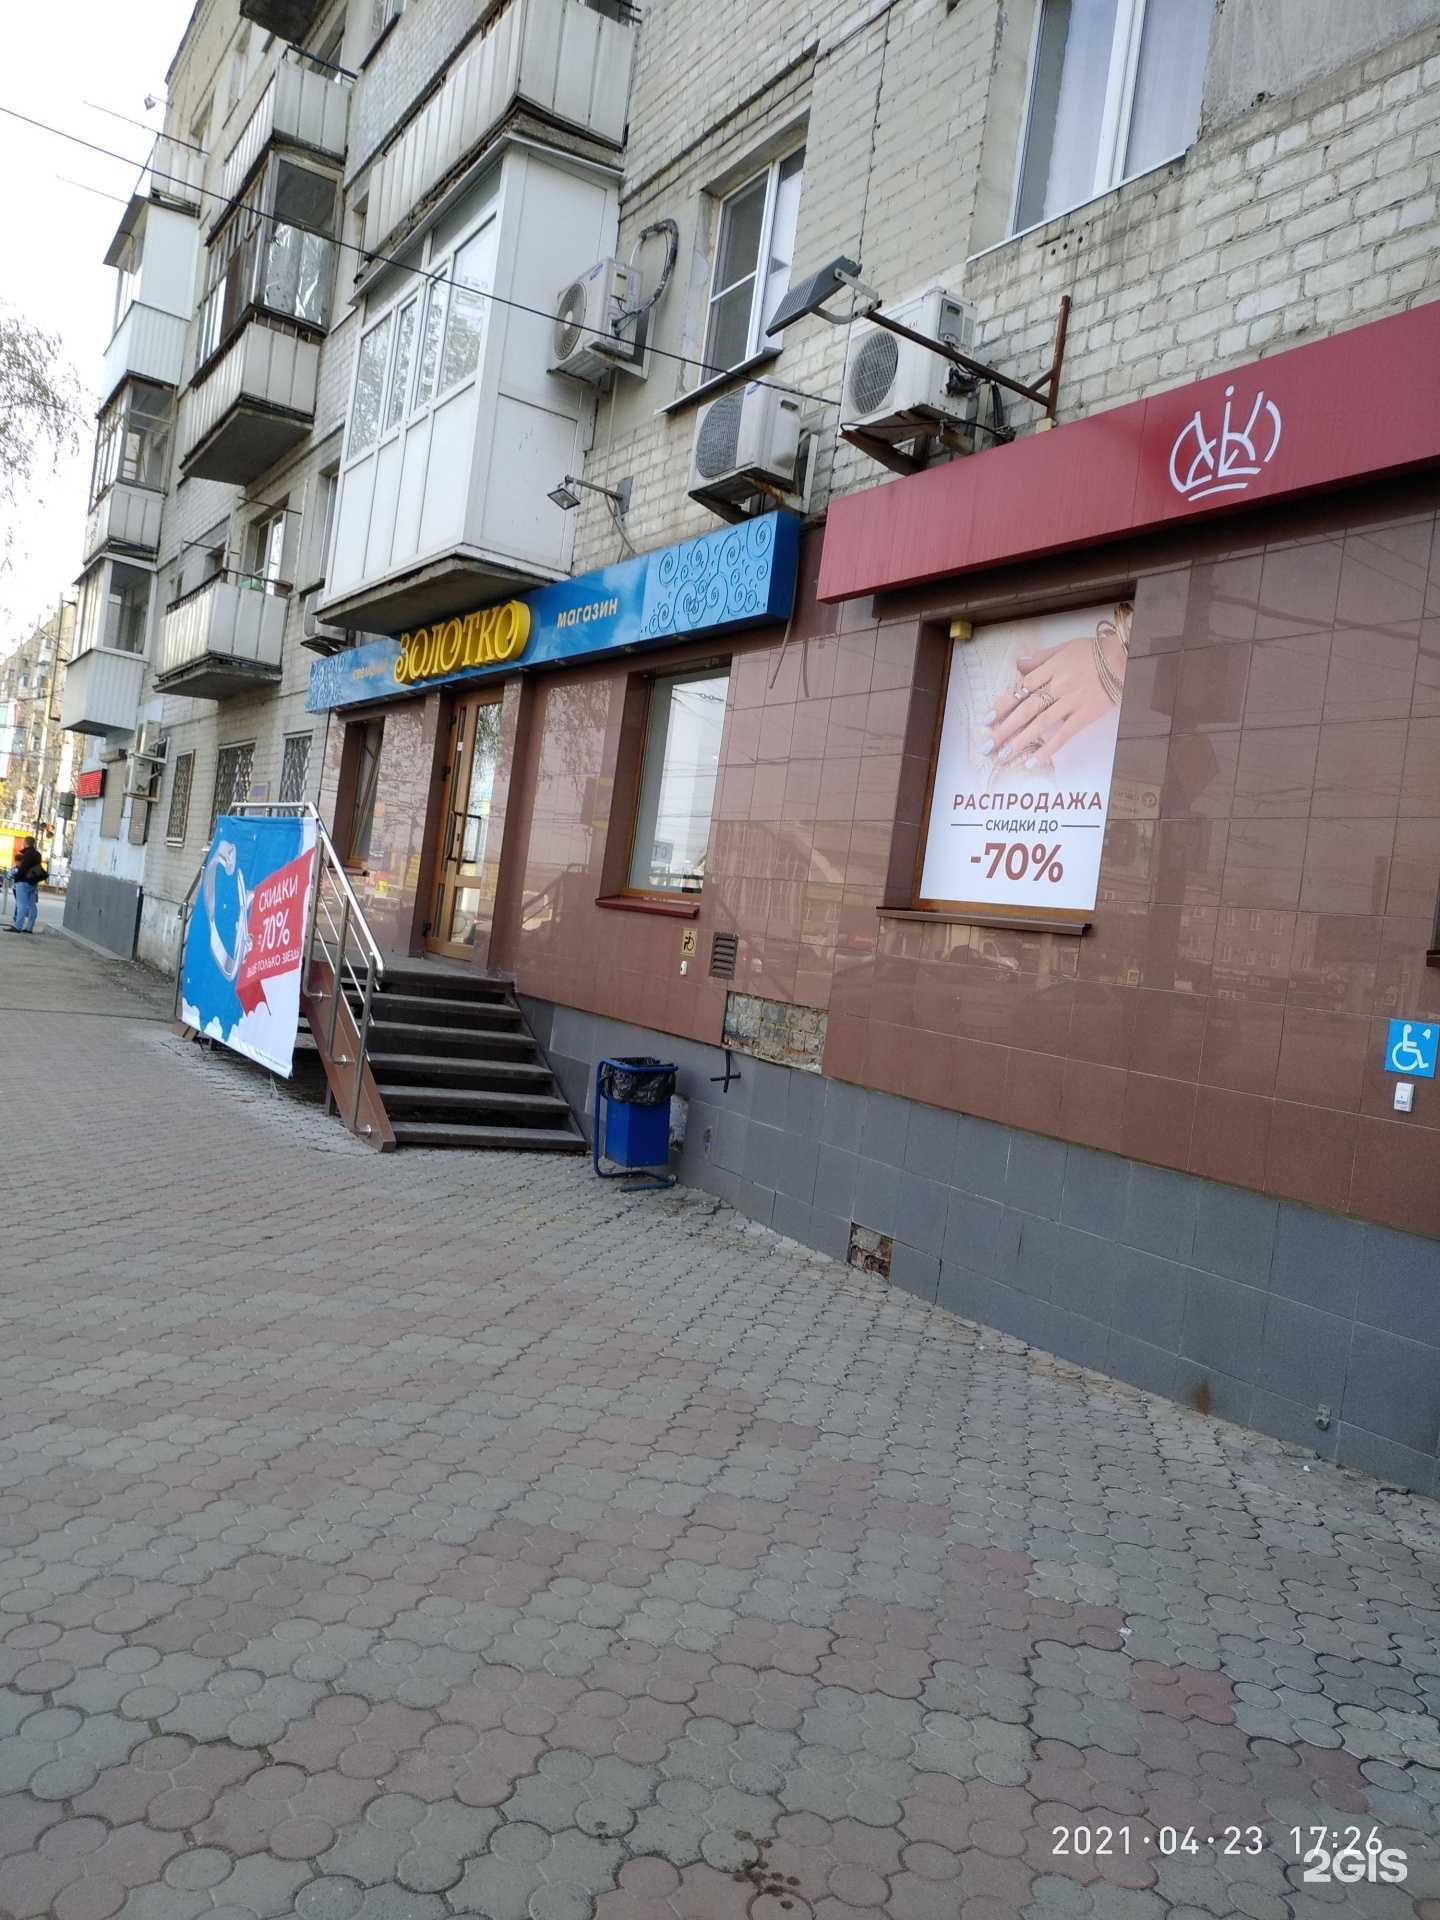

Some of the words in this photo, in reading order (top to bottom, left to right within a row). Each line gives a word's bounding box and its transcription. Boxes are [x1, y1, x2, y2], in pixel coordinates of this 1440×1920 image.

[556, 597, 619, 629] магазин
[394, 600, 528, 684] ЗОЛОТКО
[953, 792, 1102, 813] РАСПРОДАЖА
[985, 819, 1036, 834] СКИДКИ
[1038, 819, 1059, 834] ДО
[970, 842, 1064, 883] -70%
[259, 874, 299, 912] СКИДКИ
